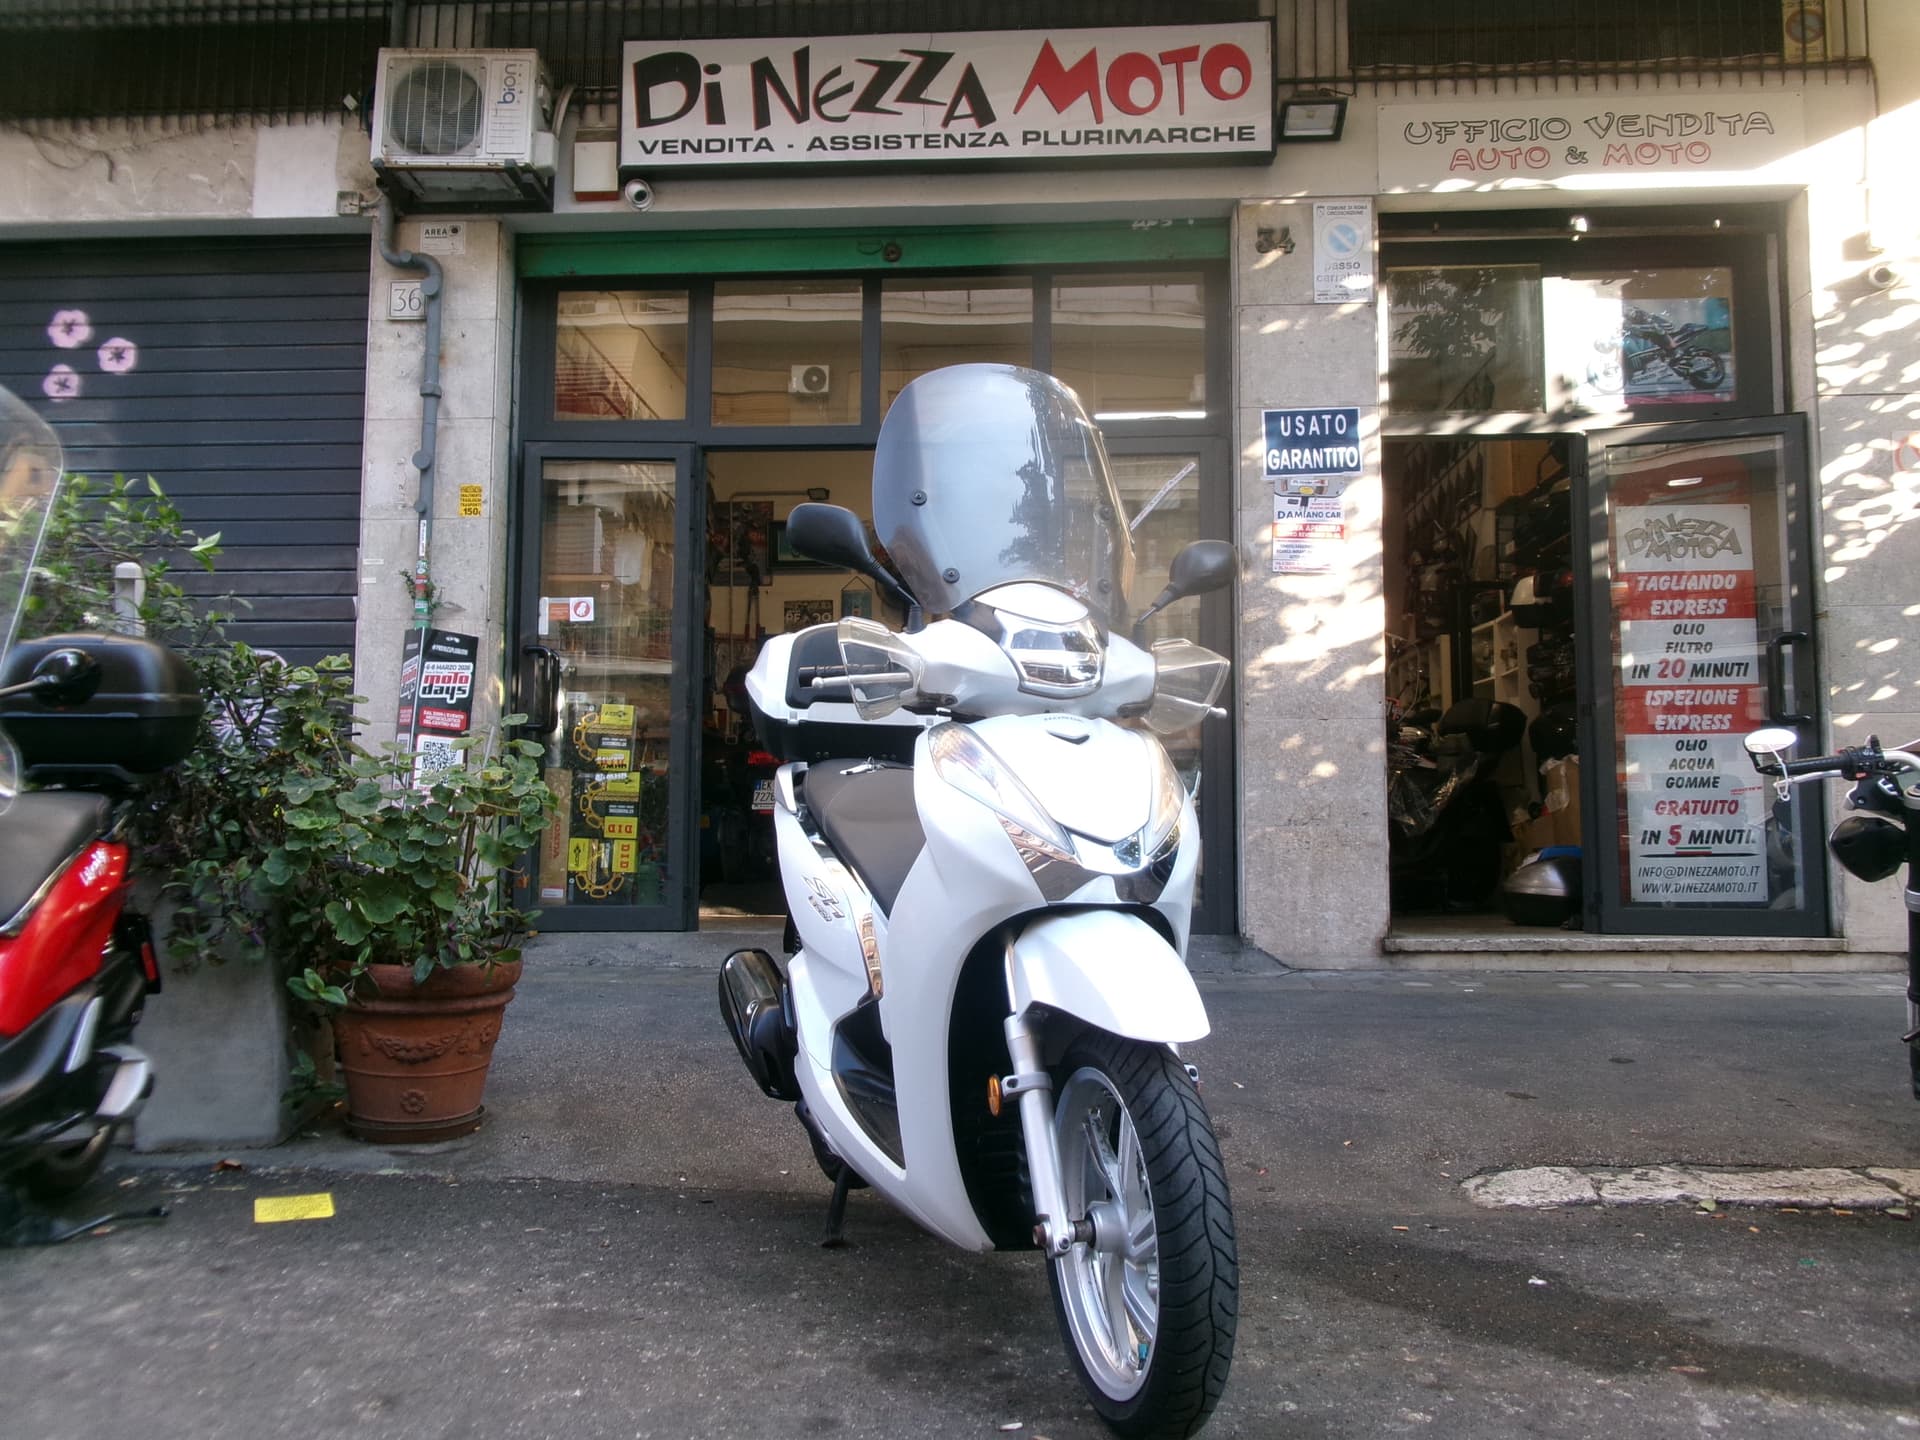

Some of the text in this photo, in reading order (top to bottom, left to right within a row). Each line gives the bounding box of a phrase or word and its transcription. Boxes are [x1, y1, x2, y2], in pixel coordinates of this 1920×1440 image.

[497, 64, 517, 105] bion
[1013, 38, 1252, 126] MOTO
[1404, 111, 1775, 145] UFFICIO VENDITA
[638, 136, 775, 155] VENDITA
[806, 131, 1010, 152] ASSISTENZA
[1021, 125, 1256, 146] PLURIMARCHE
[1450, 141, 1712, 172] AUTO & MOTO
[424, 228, 448, 236] AREA
[1255, 226, 1296, 254] 34
[393, 288, 422, 312] 36
[1280, 413, 1347, 437] USATO
[1267, 446, 1359, 470] GARANTITO
[1325, 511, 1341, 519] CAR
[1638, 574, 1737, 592] TAGLIANDO
[1650, 598, 1728, 616] EXPRESS
[1673, 623, 1705, 635] OLIO
[1665, 641, 1713, 654] FILTRO
[1631, 657, 1749, 679] IN 20 MINUTI
[424, 672, 470, 684] moto
[421, 684, 468, 701] days
[1645, 688, 1740, 706] ISPEZIONE
[1655, 714, 1733, 731] EXPRESS
[1675, 740, 1708, 751] OLIO
[1669, 758, 1715, 771] ACQUA
[1666, 776, 1720, 789] GOMME
[1655, 800, 1739, 816] GRATUITO
[1641, 830, 1661, 845] IN
[1668, 825, 1682, 846] 5
[620, 844, 631, 869] DID
[1638, 866, 1760, 879] INFO@DINEZZAMOTO.IT
[1642, 882, 1759, 894] WWW.DINEZZAMOTO.IT
